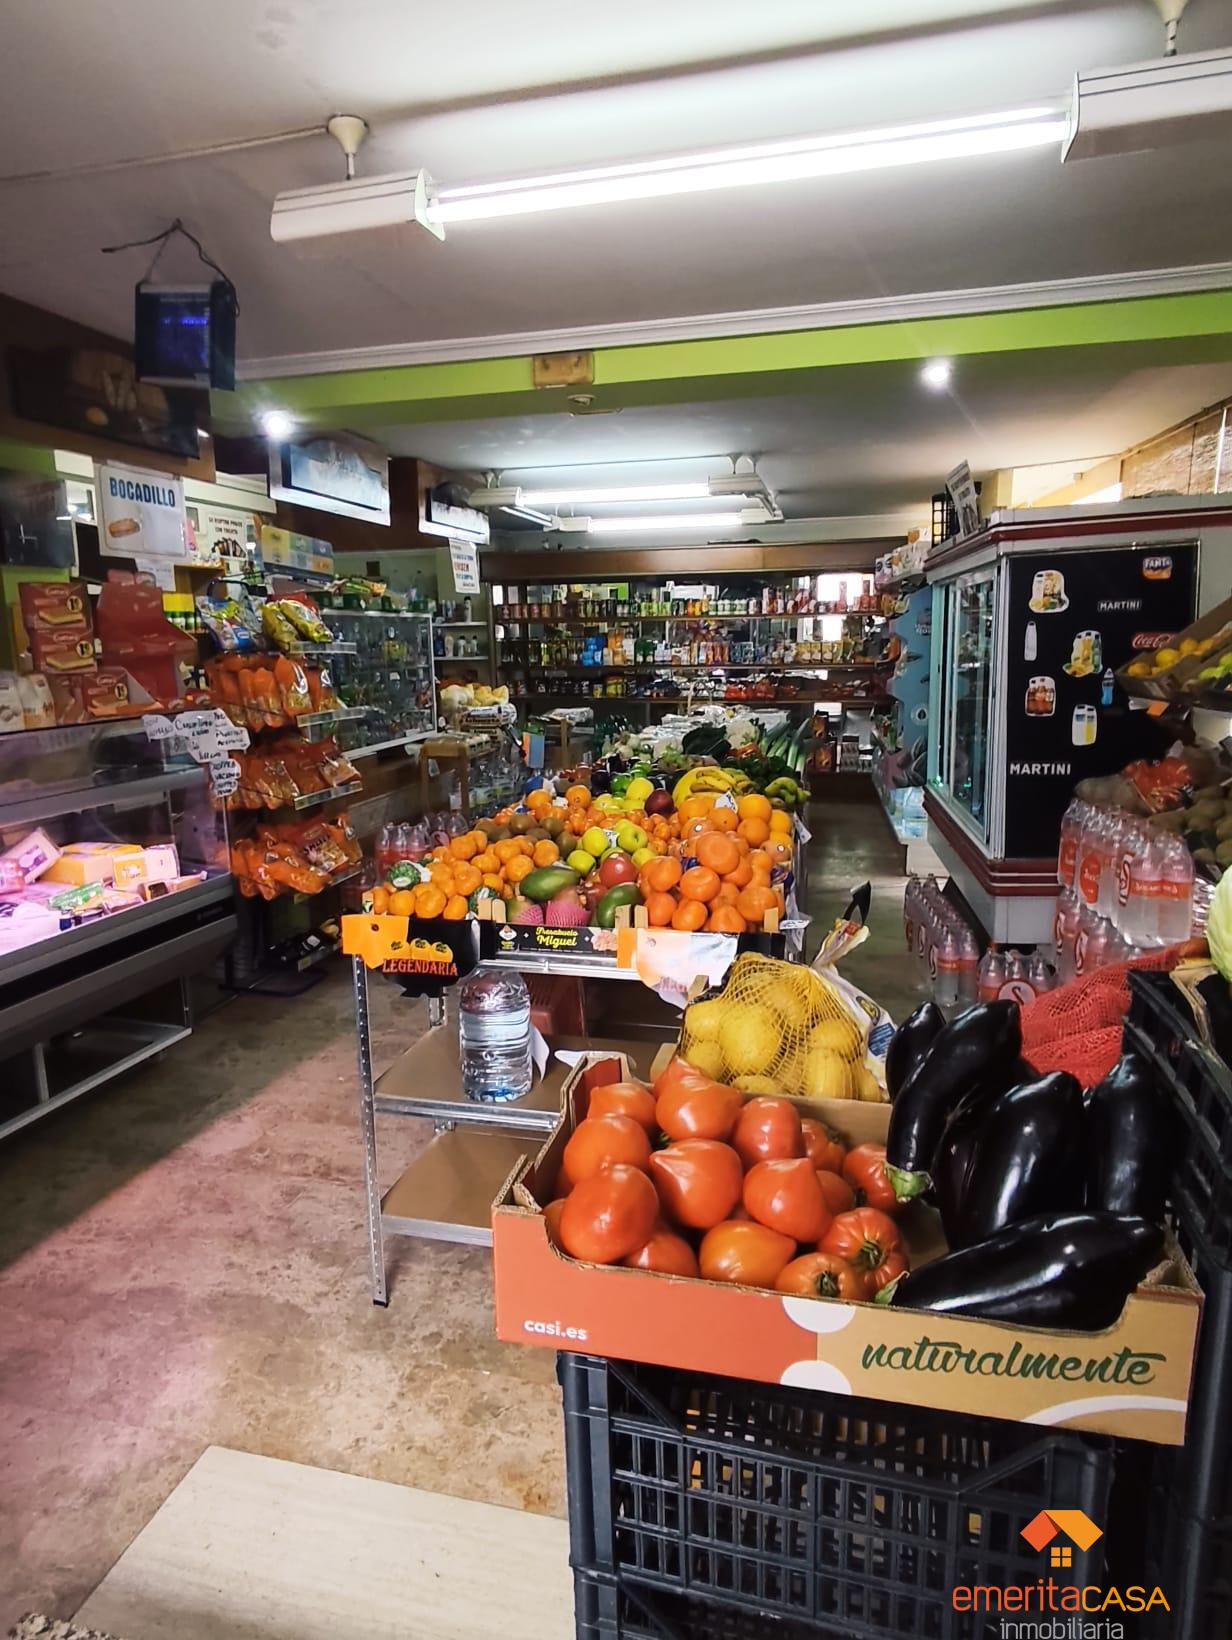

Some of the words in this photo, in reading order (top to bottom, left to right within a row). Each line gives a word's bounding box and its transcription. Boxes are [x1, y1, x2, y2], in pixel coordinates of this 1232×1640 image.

[109, 476, 176, 508] BOCADILLO
[1099, 600, 1140, 611] MARTINI
[1009, 763, 1071, 776] MARTINI
[536, 934, 578, 949] Miguel
[382, 958, 458, 977] LEGENDARIA
[523, 1319, 588, 1341] casi.es
[862, 1335, 1167, 1386] naturalmente
